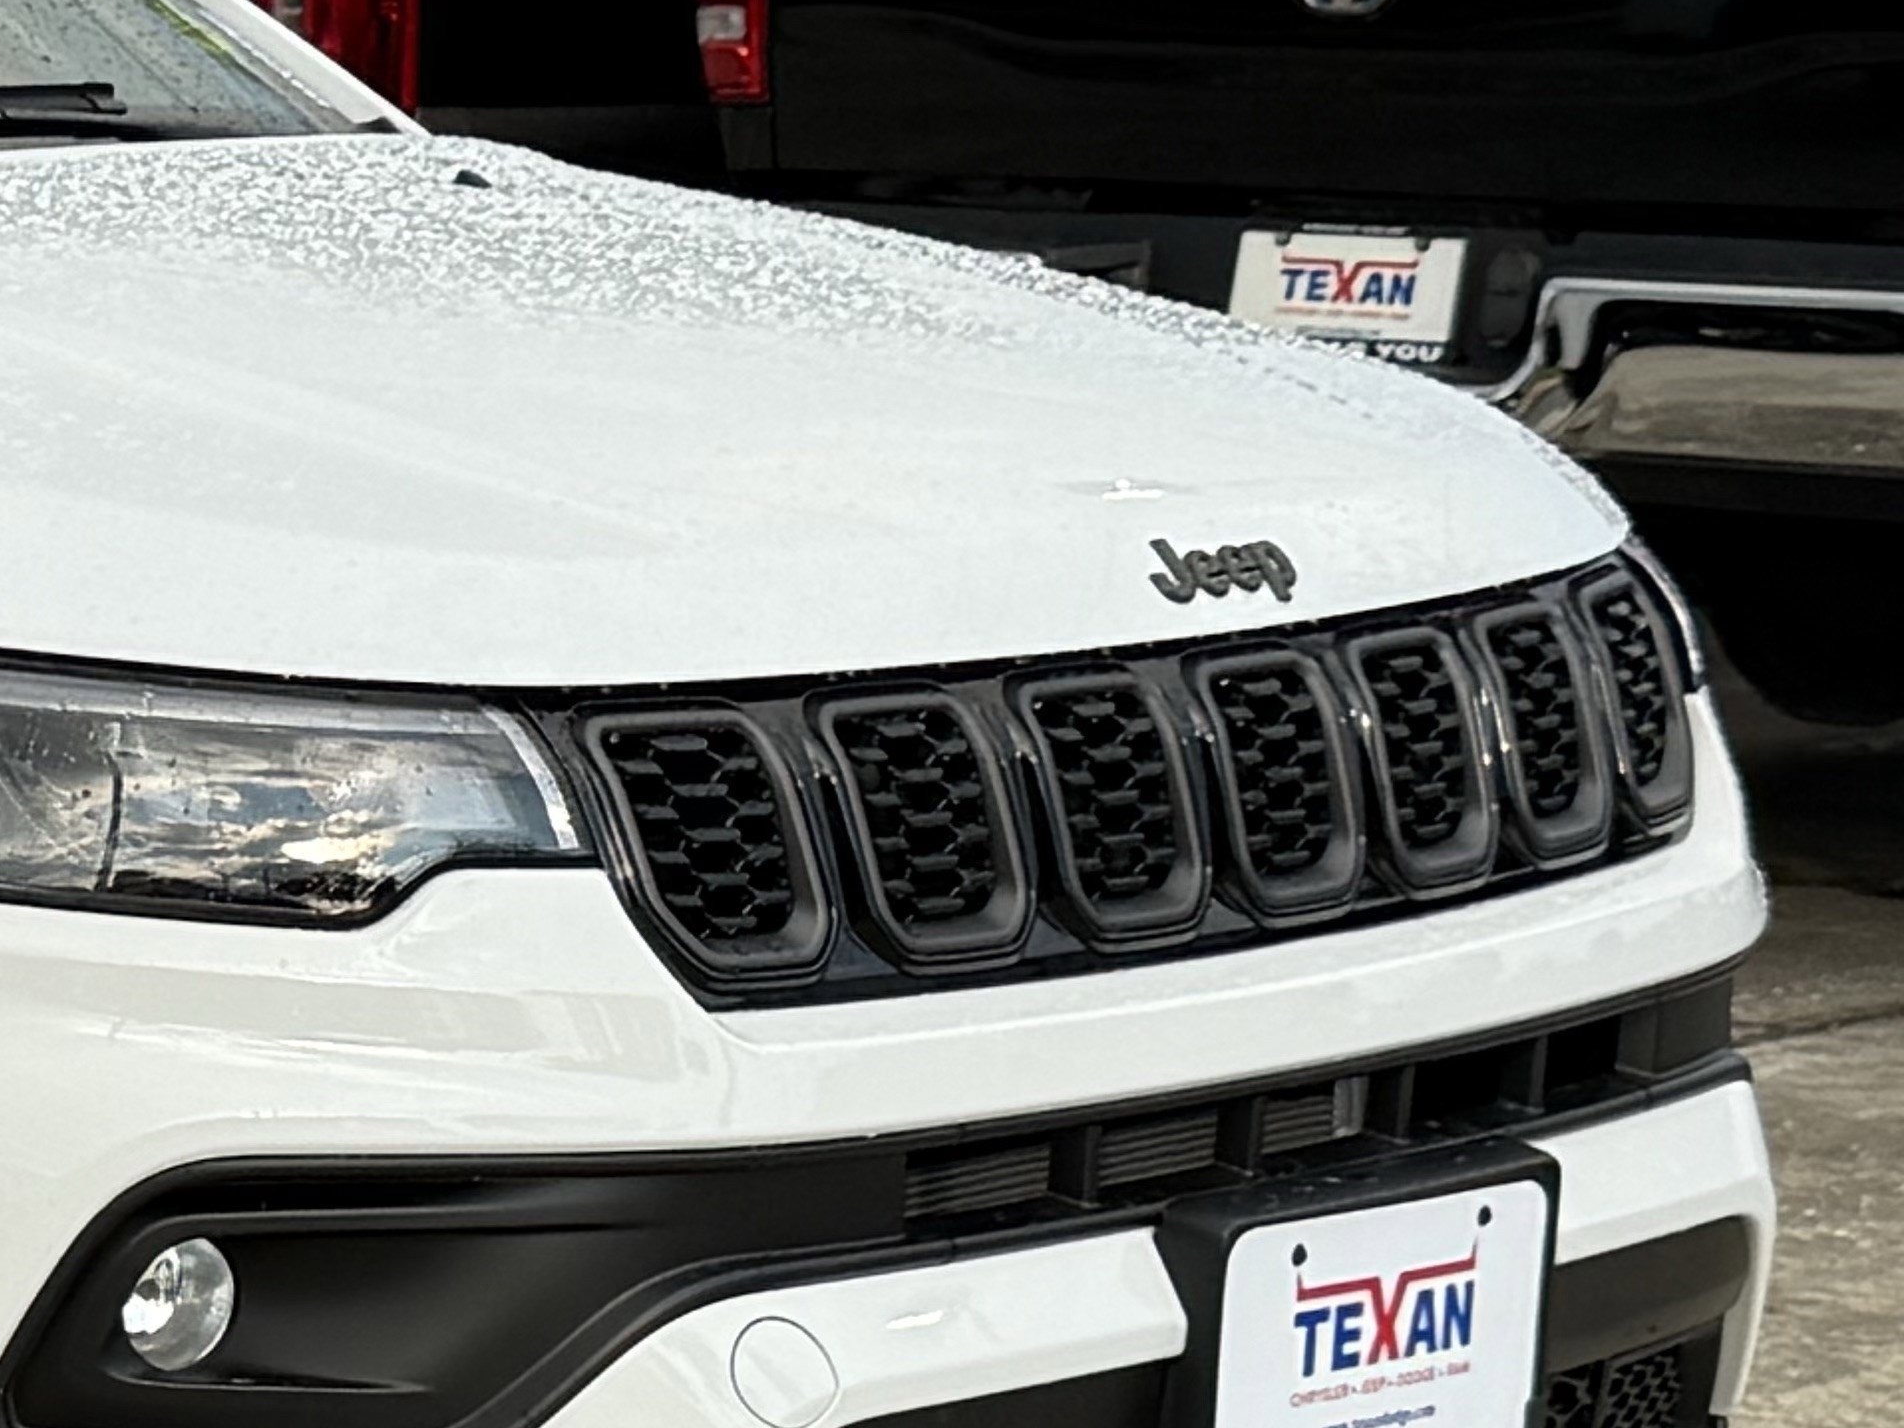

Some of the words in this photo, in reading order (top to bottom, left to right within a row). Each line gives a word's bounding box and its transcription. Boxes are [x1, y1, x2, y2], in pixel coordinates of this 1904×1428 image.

[1280, 256, 1418, 306] TEXAN
[1149, 538, 1297, 604] Jeep
[1293, 1275, 1476, 1378] TEXAN
